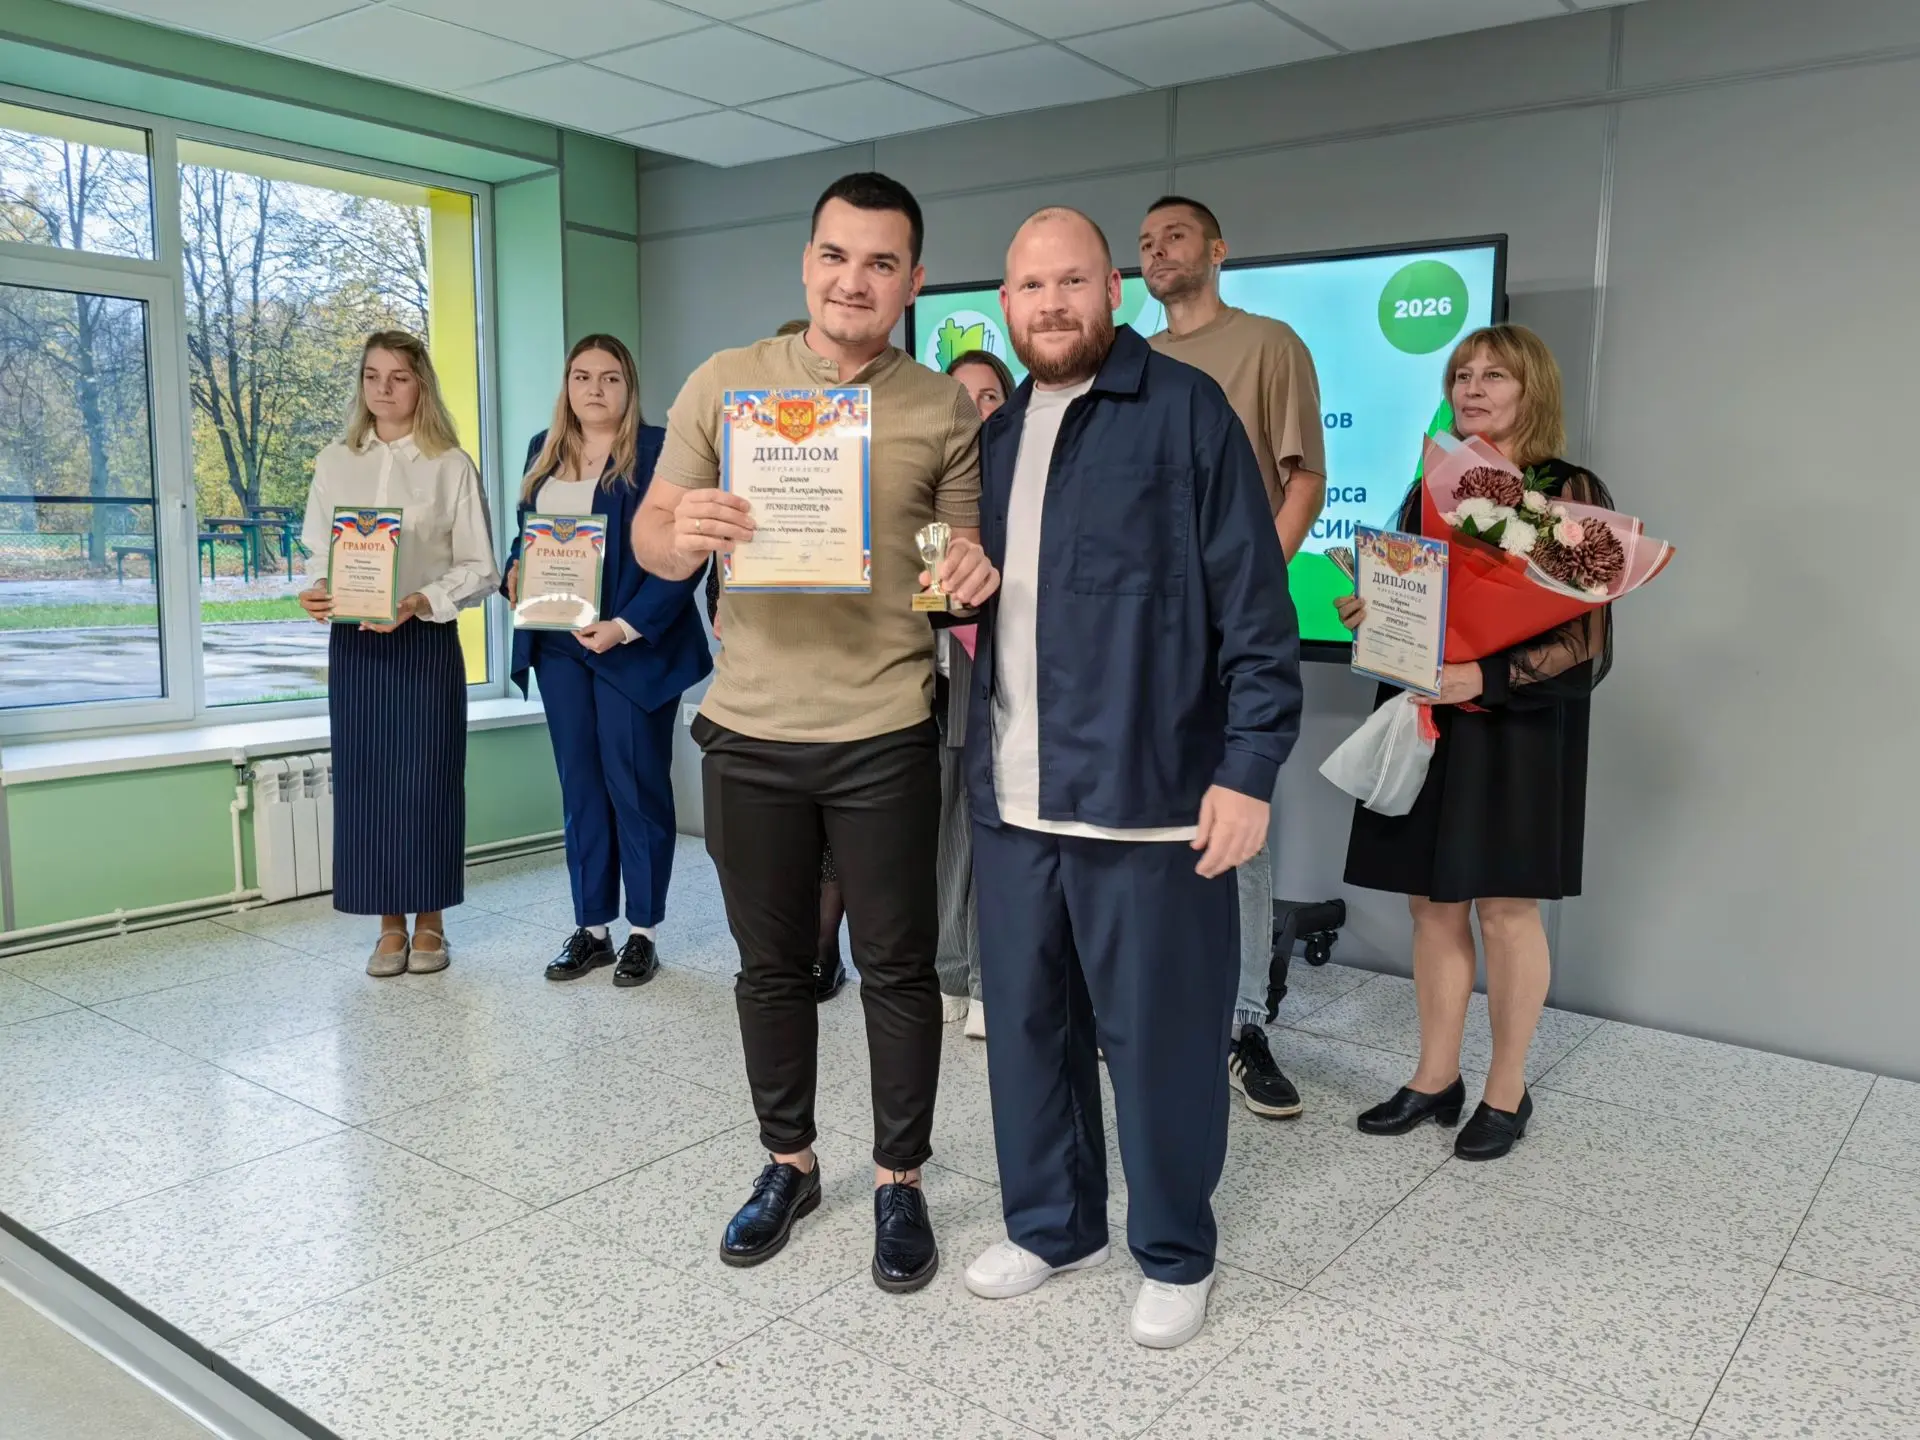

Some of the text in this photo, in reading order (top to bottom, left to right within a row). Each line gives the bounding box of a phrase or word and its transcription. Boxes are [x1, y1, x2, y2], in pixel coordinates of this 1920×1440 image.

[1394, 296, 1452, 318] 2026
[1322, 412, 1353, 429] ов
[752, 447, 839, 462] ДИПЛОМ
[1327, 486, 1367, 508] рса
[1310, 518, 1360, 540] СИИ
[343, 541, 386, 551] ГРАМОТА
[536, 547, 587, 558] ГРАМОТА
[1372, 571, 1427, 594] ДИПЛОМ
